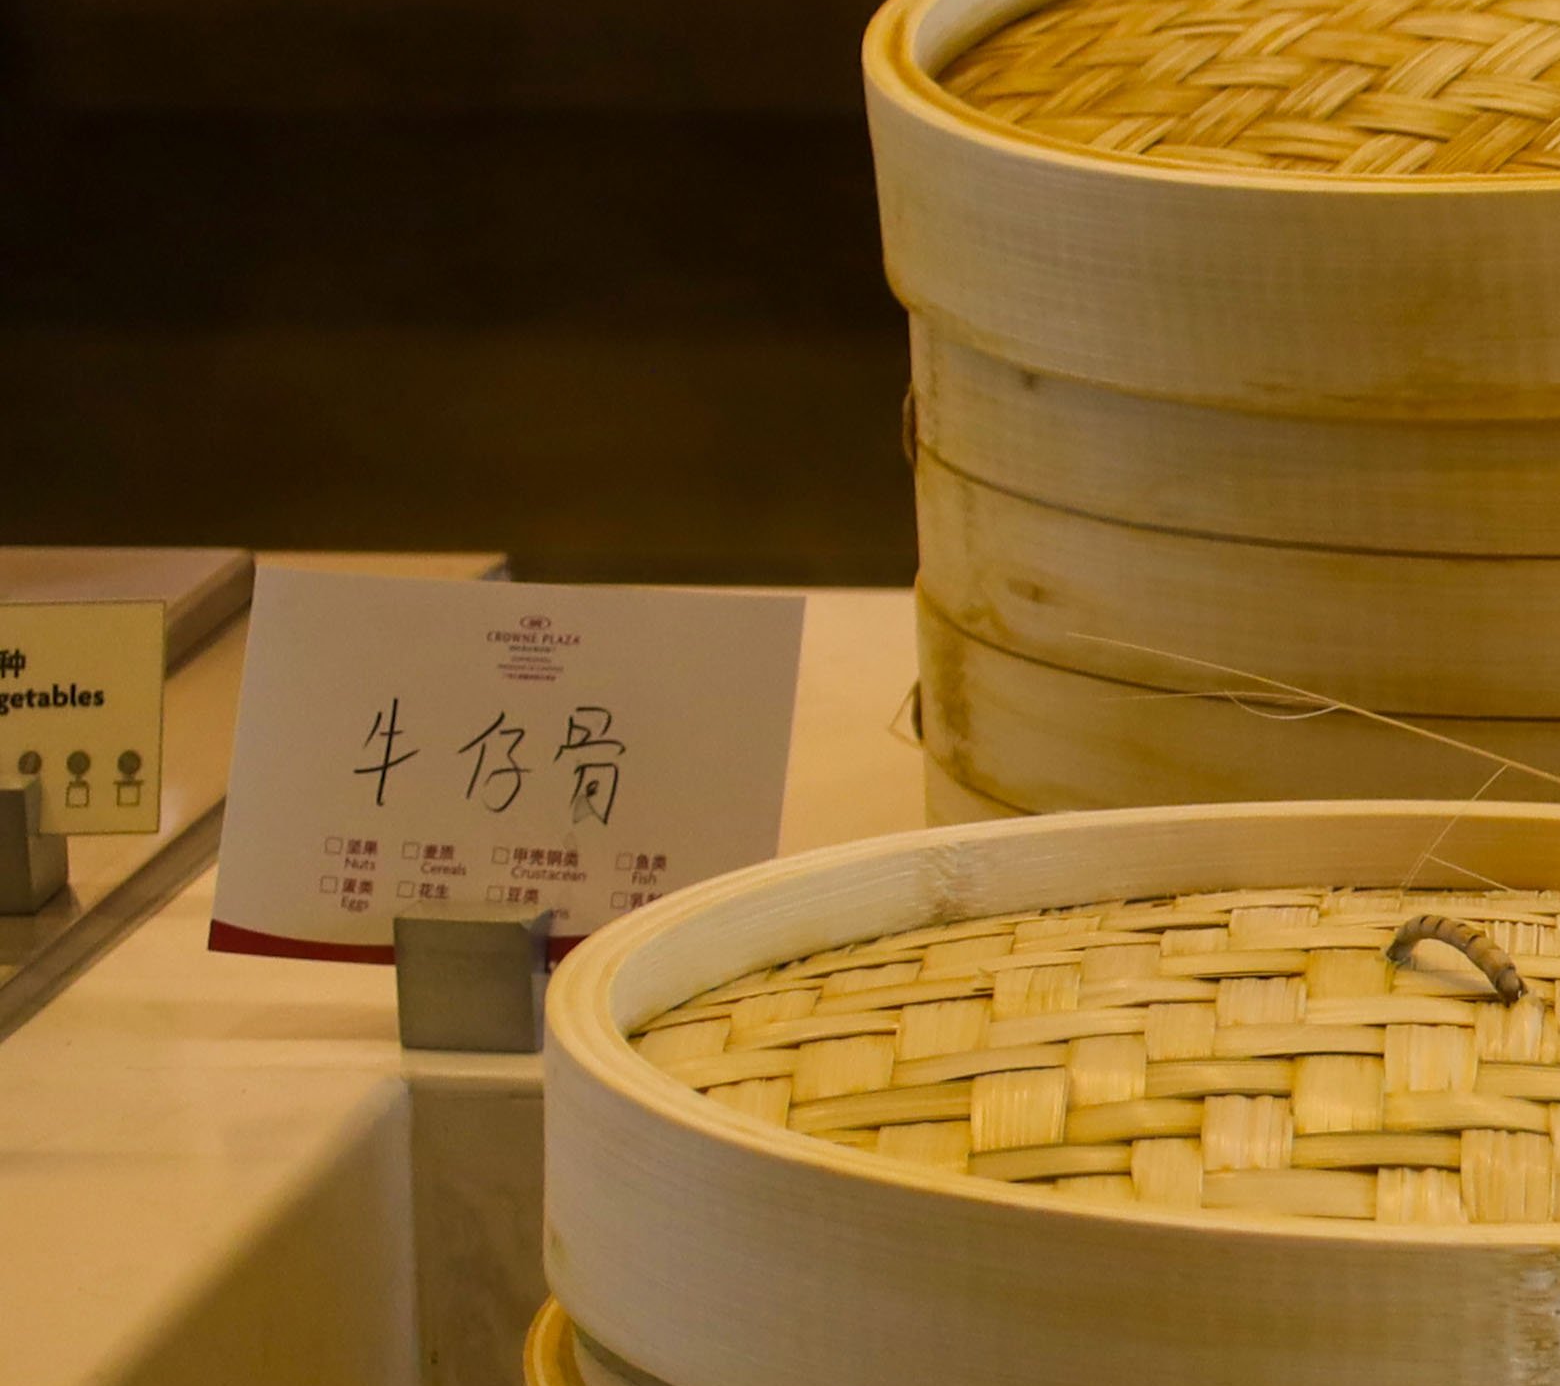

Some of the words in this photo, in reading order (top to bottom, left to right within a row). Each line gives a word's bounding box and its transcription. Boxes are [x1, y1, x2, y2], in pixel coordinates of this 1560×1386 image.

[354, 698, 626, 825] 牛仔骨
[345, 858, 376, 871] Nuts
[421, 862, 467, 876] Cereals
[511, 866, 587, 883] Crustacean
[631, 871, 657, 885] Fish
[341, 896, 369, 912] Eggs
